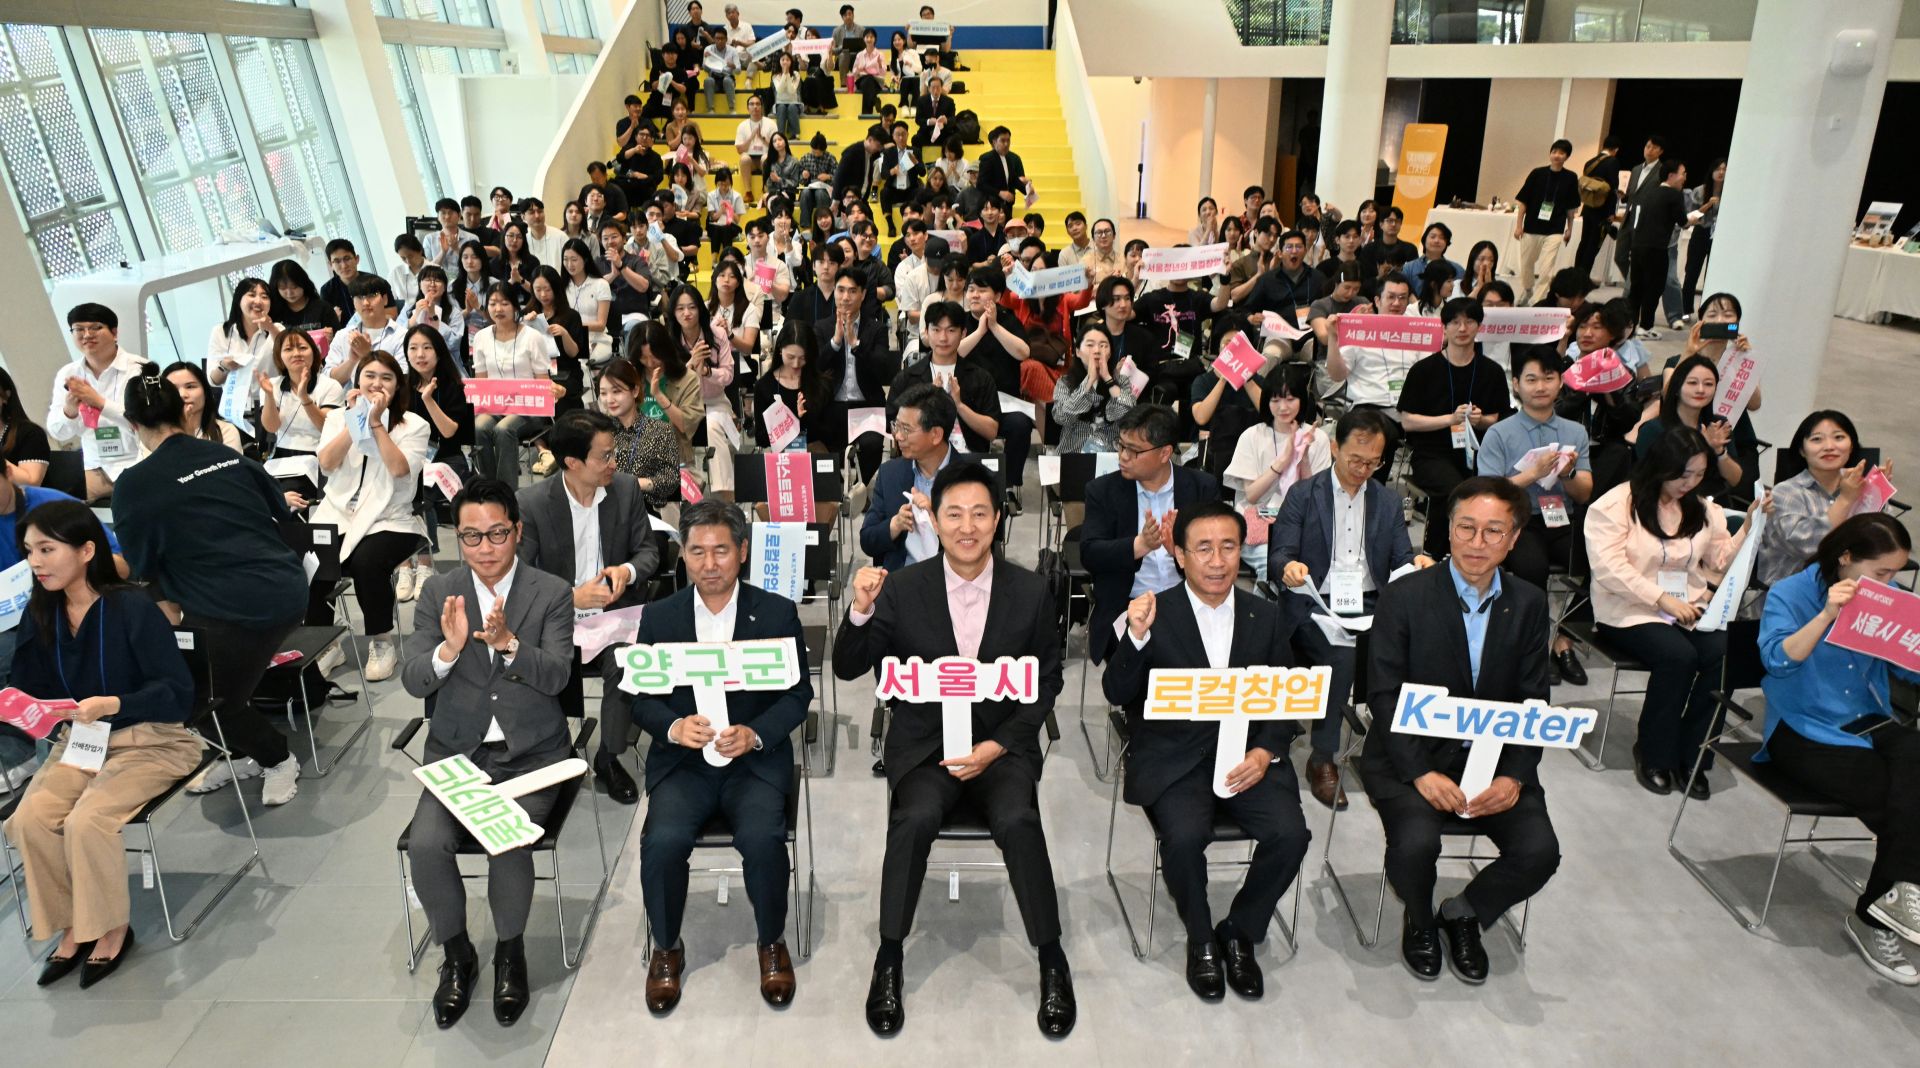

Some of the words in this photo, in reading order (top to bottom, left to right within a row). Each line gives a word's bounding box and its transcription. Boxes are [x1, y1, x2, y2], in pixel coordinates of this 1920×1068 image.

[1345, 329, 1377, 341] 서울시
[1379, 330, 1433, 345] 넥스트로컬
[1519, 324, 1560, 335] 로컬창업
[1725, 358, 1755, 402] 로컬창업
[493, 394, 545, 408] 넥스트로컬
[177, 472, 196, 485] Your
[194, 464, 219, 477] Growth
[216, 458, 240, 469] Partner
[775, 452, 795, 517] 넥스트로컬
[763, 533, 781, 592] 로컬창업
[1850, 610, 1902, 642] 서울시
[626, 647, 787, 688] 양구군
[881, 661, 1033, 698] 서울시
[1150, 673, 1324, 715] 로컬창업
[1399, 691, 1591, 744] K-water
[423, 757, 535, 848] 롯데카드
